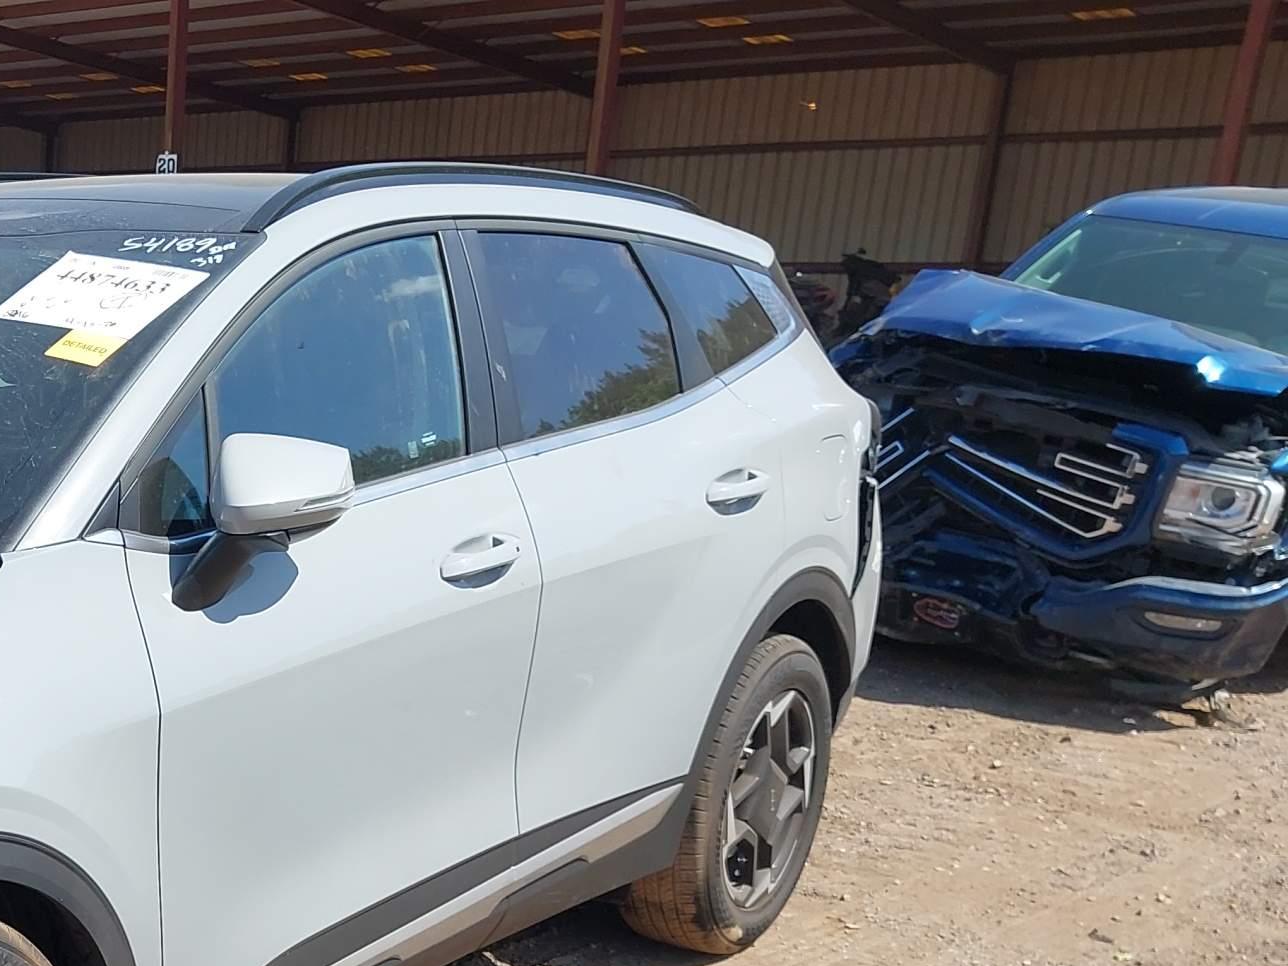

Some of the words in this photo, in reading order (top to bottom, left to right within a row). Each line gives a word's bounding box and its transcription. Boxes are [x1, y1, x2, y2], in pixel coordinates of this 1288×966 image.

[157, 157, 176, 174] 20
[56, 268, 171, 294] 44874633
[62, 339, 108, 354] DETAILED
